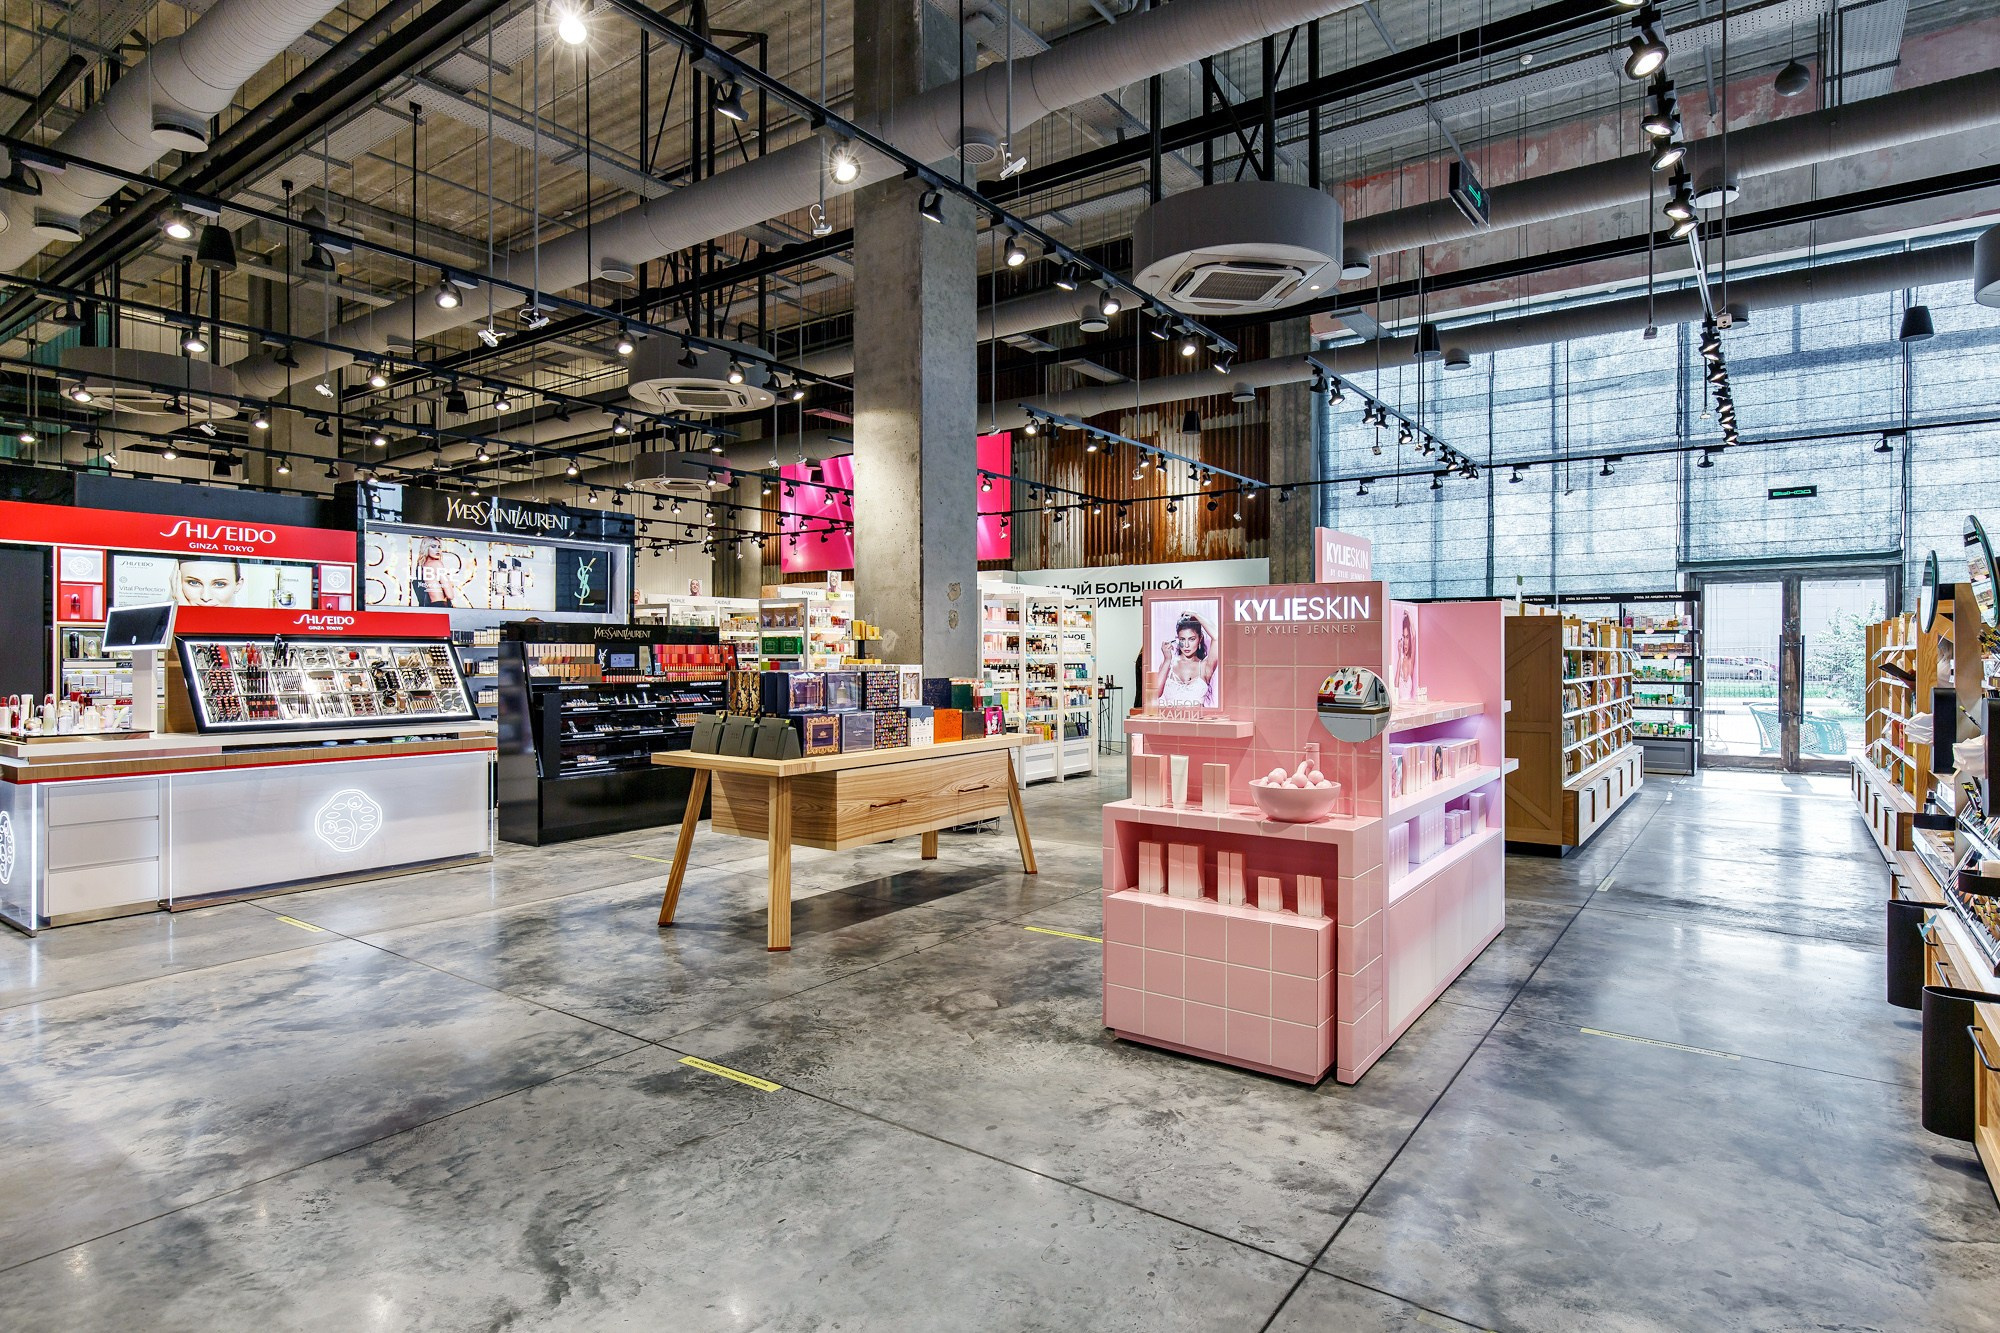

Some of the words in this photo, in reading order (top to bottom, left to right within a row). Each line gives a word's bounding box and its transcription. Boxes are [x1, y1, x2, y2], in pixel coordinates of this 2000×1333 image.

[160, 520, 277, 544] SHISEIDO
[189, 542, 219, 551] GINZA
[223, 544, 255, 553] TOKYO
[1326, 542, 1369, 570] KYLIESKIN
[1234, 595, 1370, 622] KYLIESKIN
[293, 614, 355, 626] SHISEIDO
[1244, 625, 1258, 635] BY
[1266, 624, 1299, 635] KYLIE
[1307, 624, 1357, 635] JENNER
[1158, 699, 1201, 708] ВЫБОР
[1159, 708, 1200, 720] КАЙЛИ
